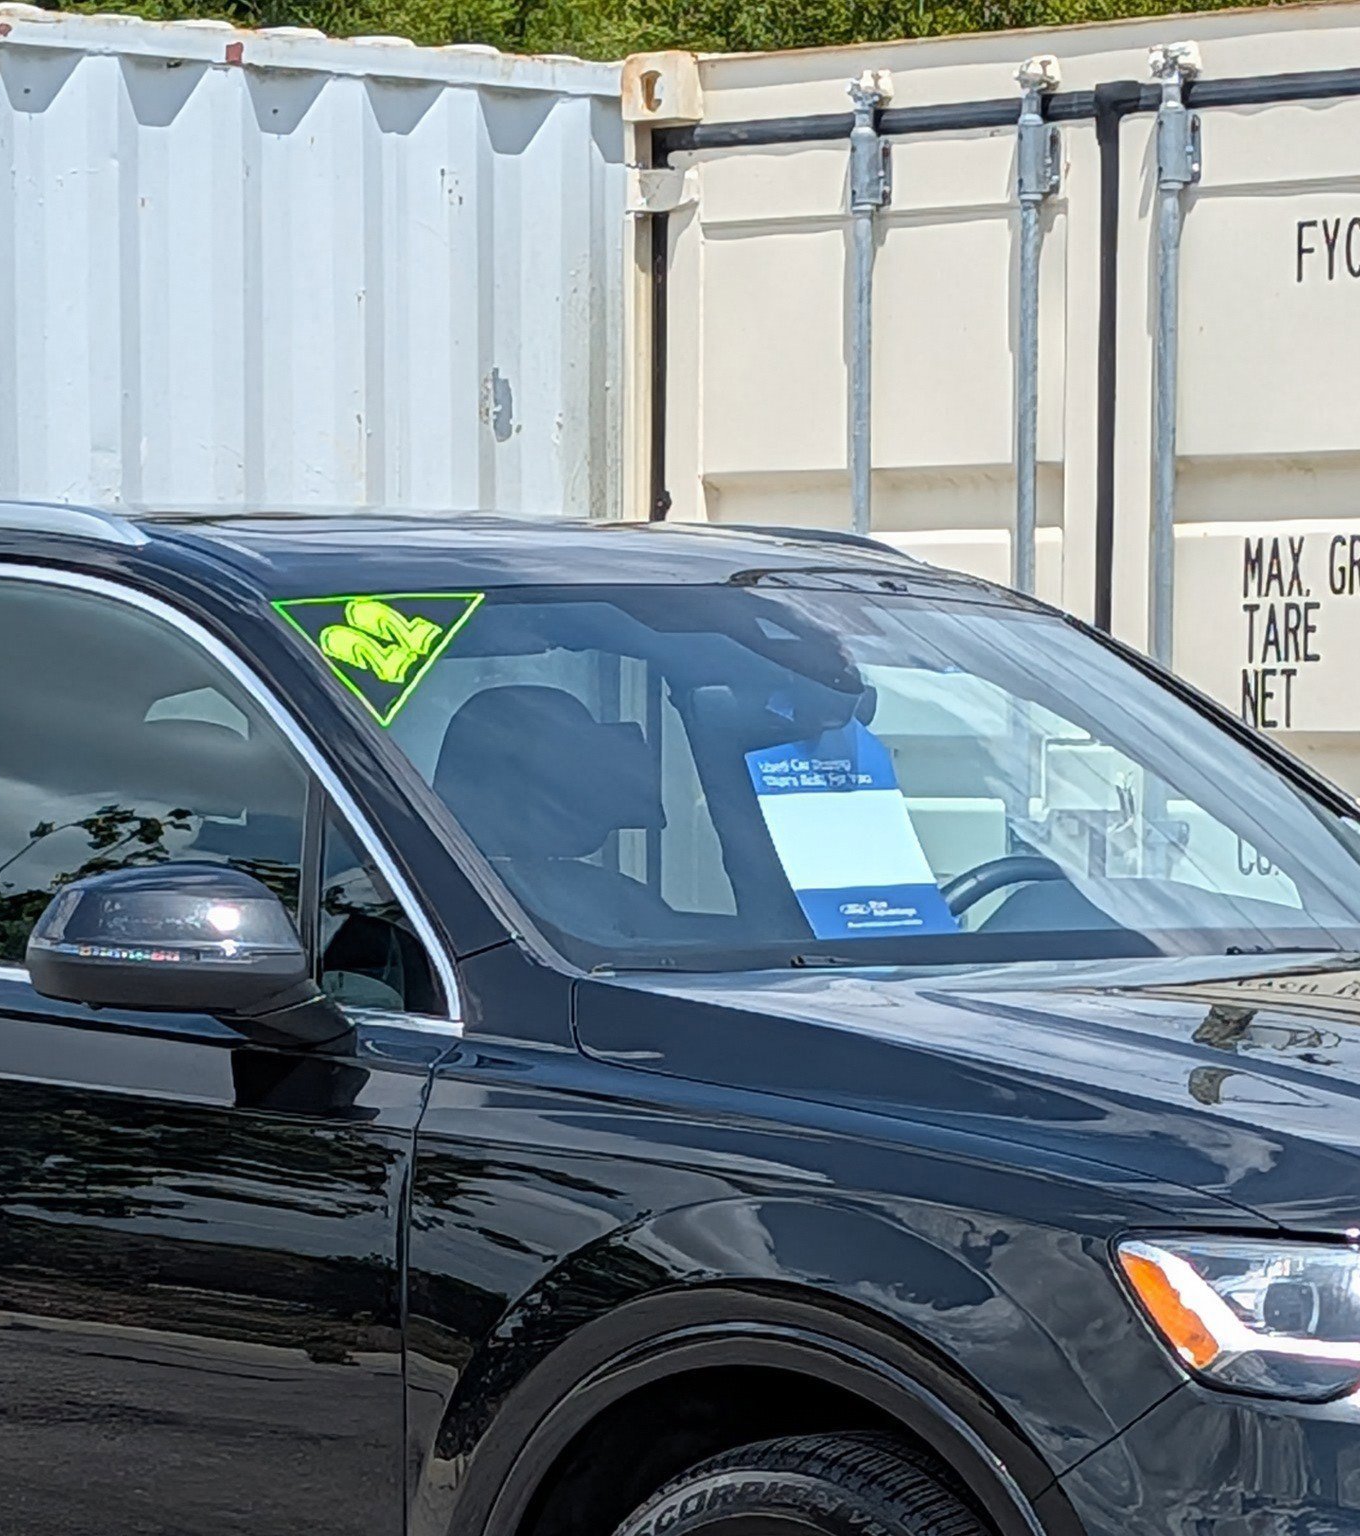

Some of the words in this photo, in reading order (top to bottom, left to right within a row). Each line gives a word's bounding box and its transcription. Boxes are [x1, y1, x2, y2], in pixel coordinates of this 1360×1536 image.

[1243, 536, 1311, 598] MAX.
[319, 597, 443, 683] 22
[1242, 601, 1321, 664] TARE
[1241, 668, 1298, 729] NET
